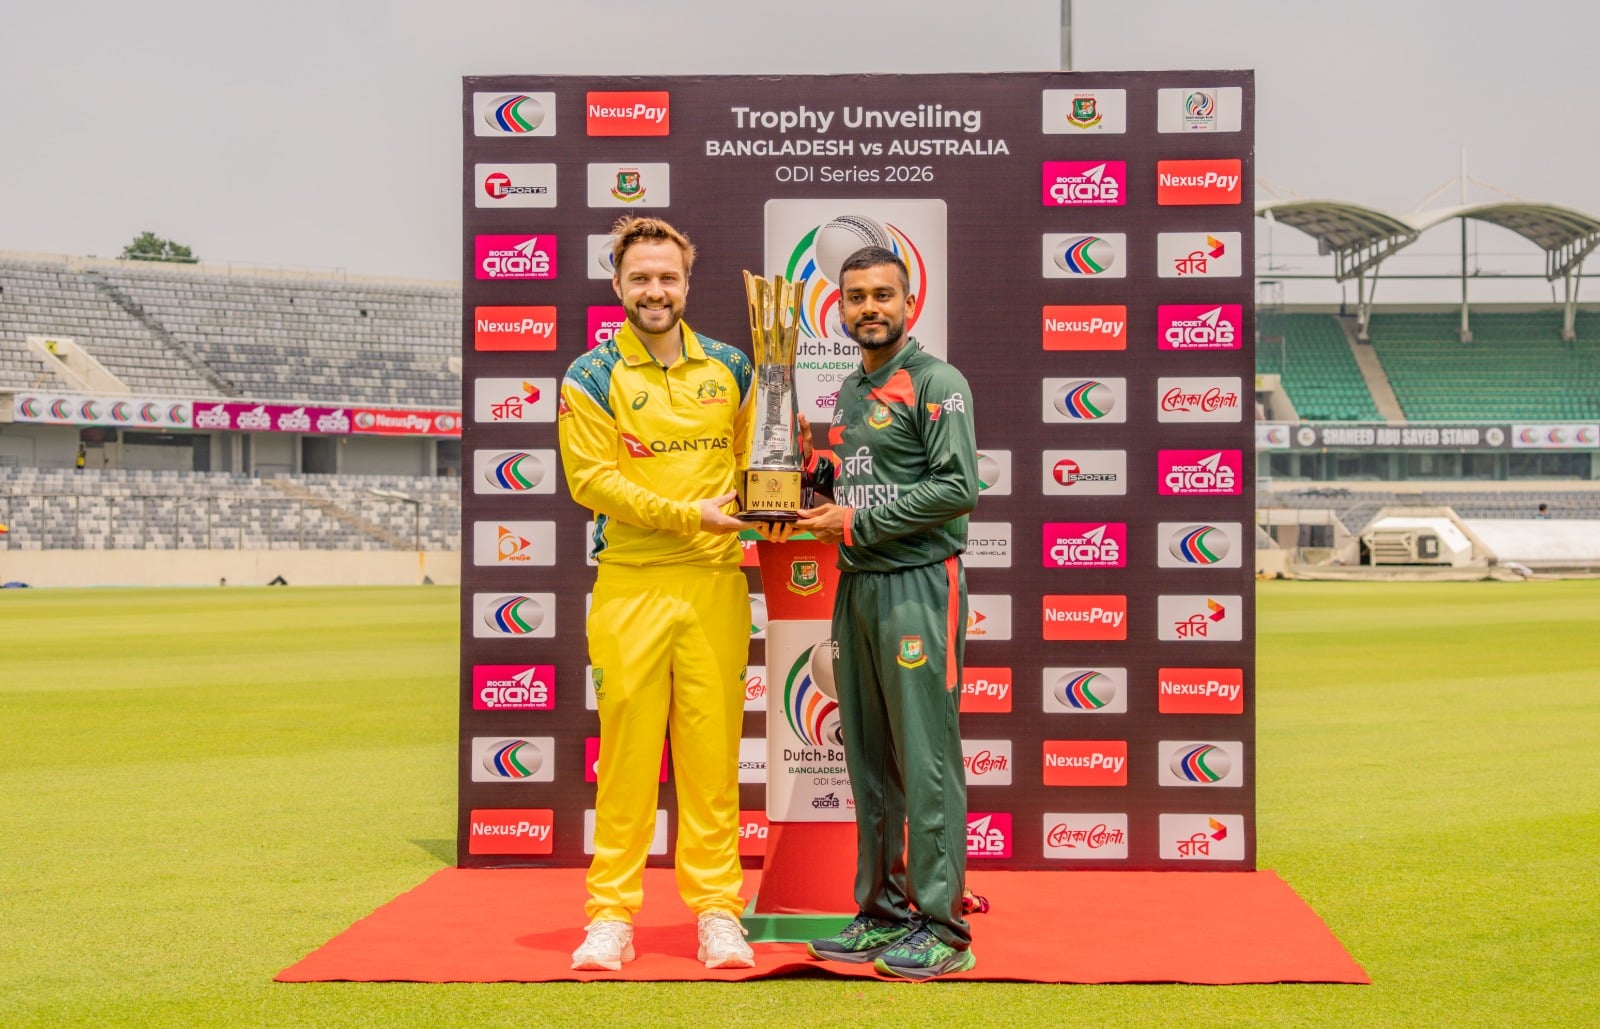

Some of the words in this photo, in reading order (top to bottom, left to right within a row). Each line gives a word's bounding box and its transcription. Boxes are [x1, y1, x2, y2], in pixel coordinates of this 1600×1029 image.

[589, 104, 667, 123] NexusPay
[731, 105, 835, 134] Trophy
[843, 104, 982, 133] Unveiling
[706, 140, 854, 156] BANGLADESH
[860, 142, 882, 156] vs
[888, 139, 1010, 156] AUSTRALIA
[775, 166, 814, 182] ODI
[820, 165, 880, 182] Series
[885, 165, 934, 182] 2026
[1159, 172, 1239, 192] NexusPay
[1174, 251, 1207, 276] রবি
[477, 318, 554, 338] NexusPay
[1045, 318, 1124, 337] NexusPay
[796, 362, 854, 370] ANGLADESH
[817, 374, 835, 382] ODI
[491, 396, 523, 421] রবি
[942, 393, 965, 415] রবি
[650, 437, 729, 453] QANTAS
[844, 446, 873, 478] রবি
[751, 500, 796, 508] WINNER
[1045, 607, 1124, 627] NexusPay
[1175, 614, 1208, 639] রবি
[961, 679, 1009, 700] usPay
[1161, 680, 1240, 701] NexusPay
[788, 766, 846, 774] BANGLADESH
[1045, 753, 1125, 773] NexusPay
[813, 777, 829, 786] ODI
[831, 777, 851, 786] Serie
[472, 821, 550, 842] NexusPay
[1176, 832, 1209, 858] রবি
